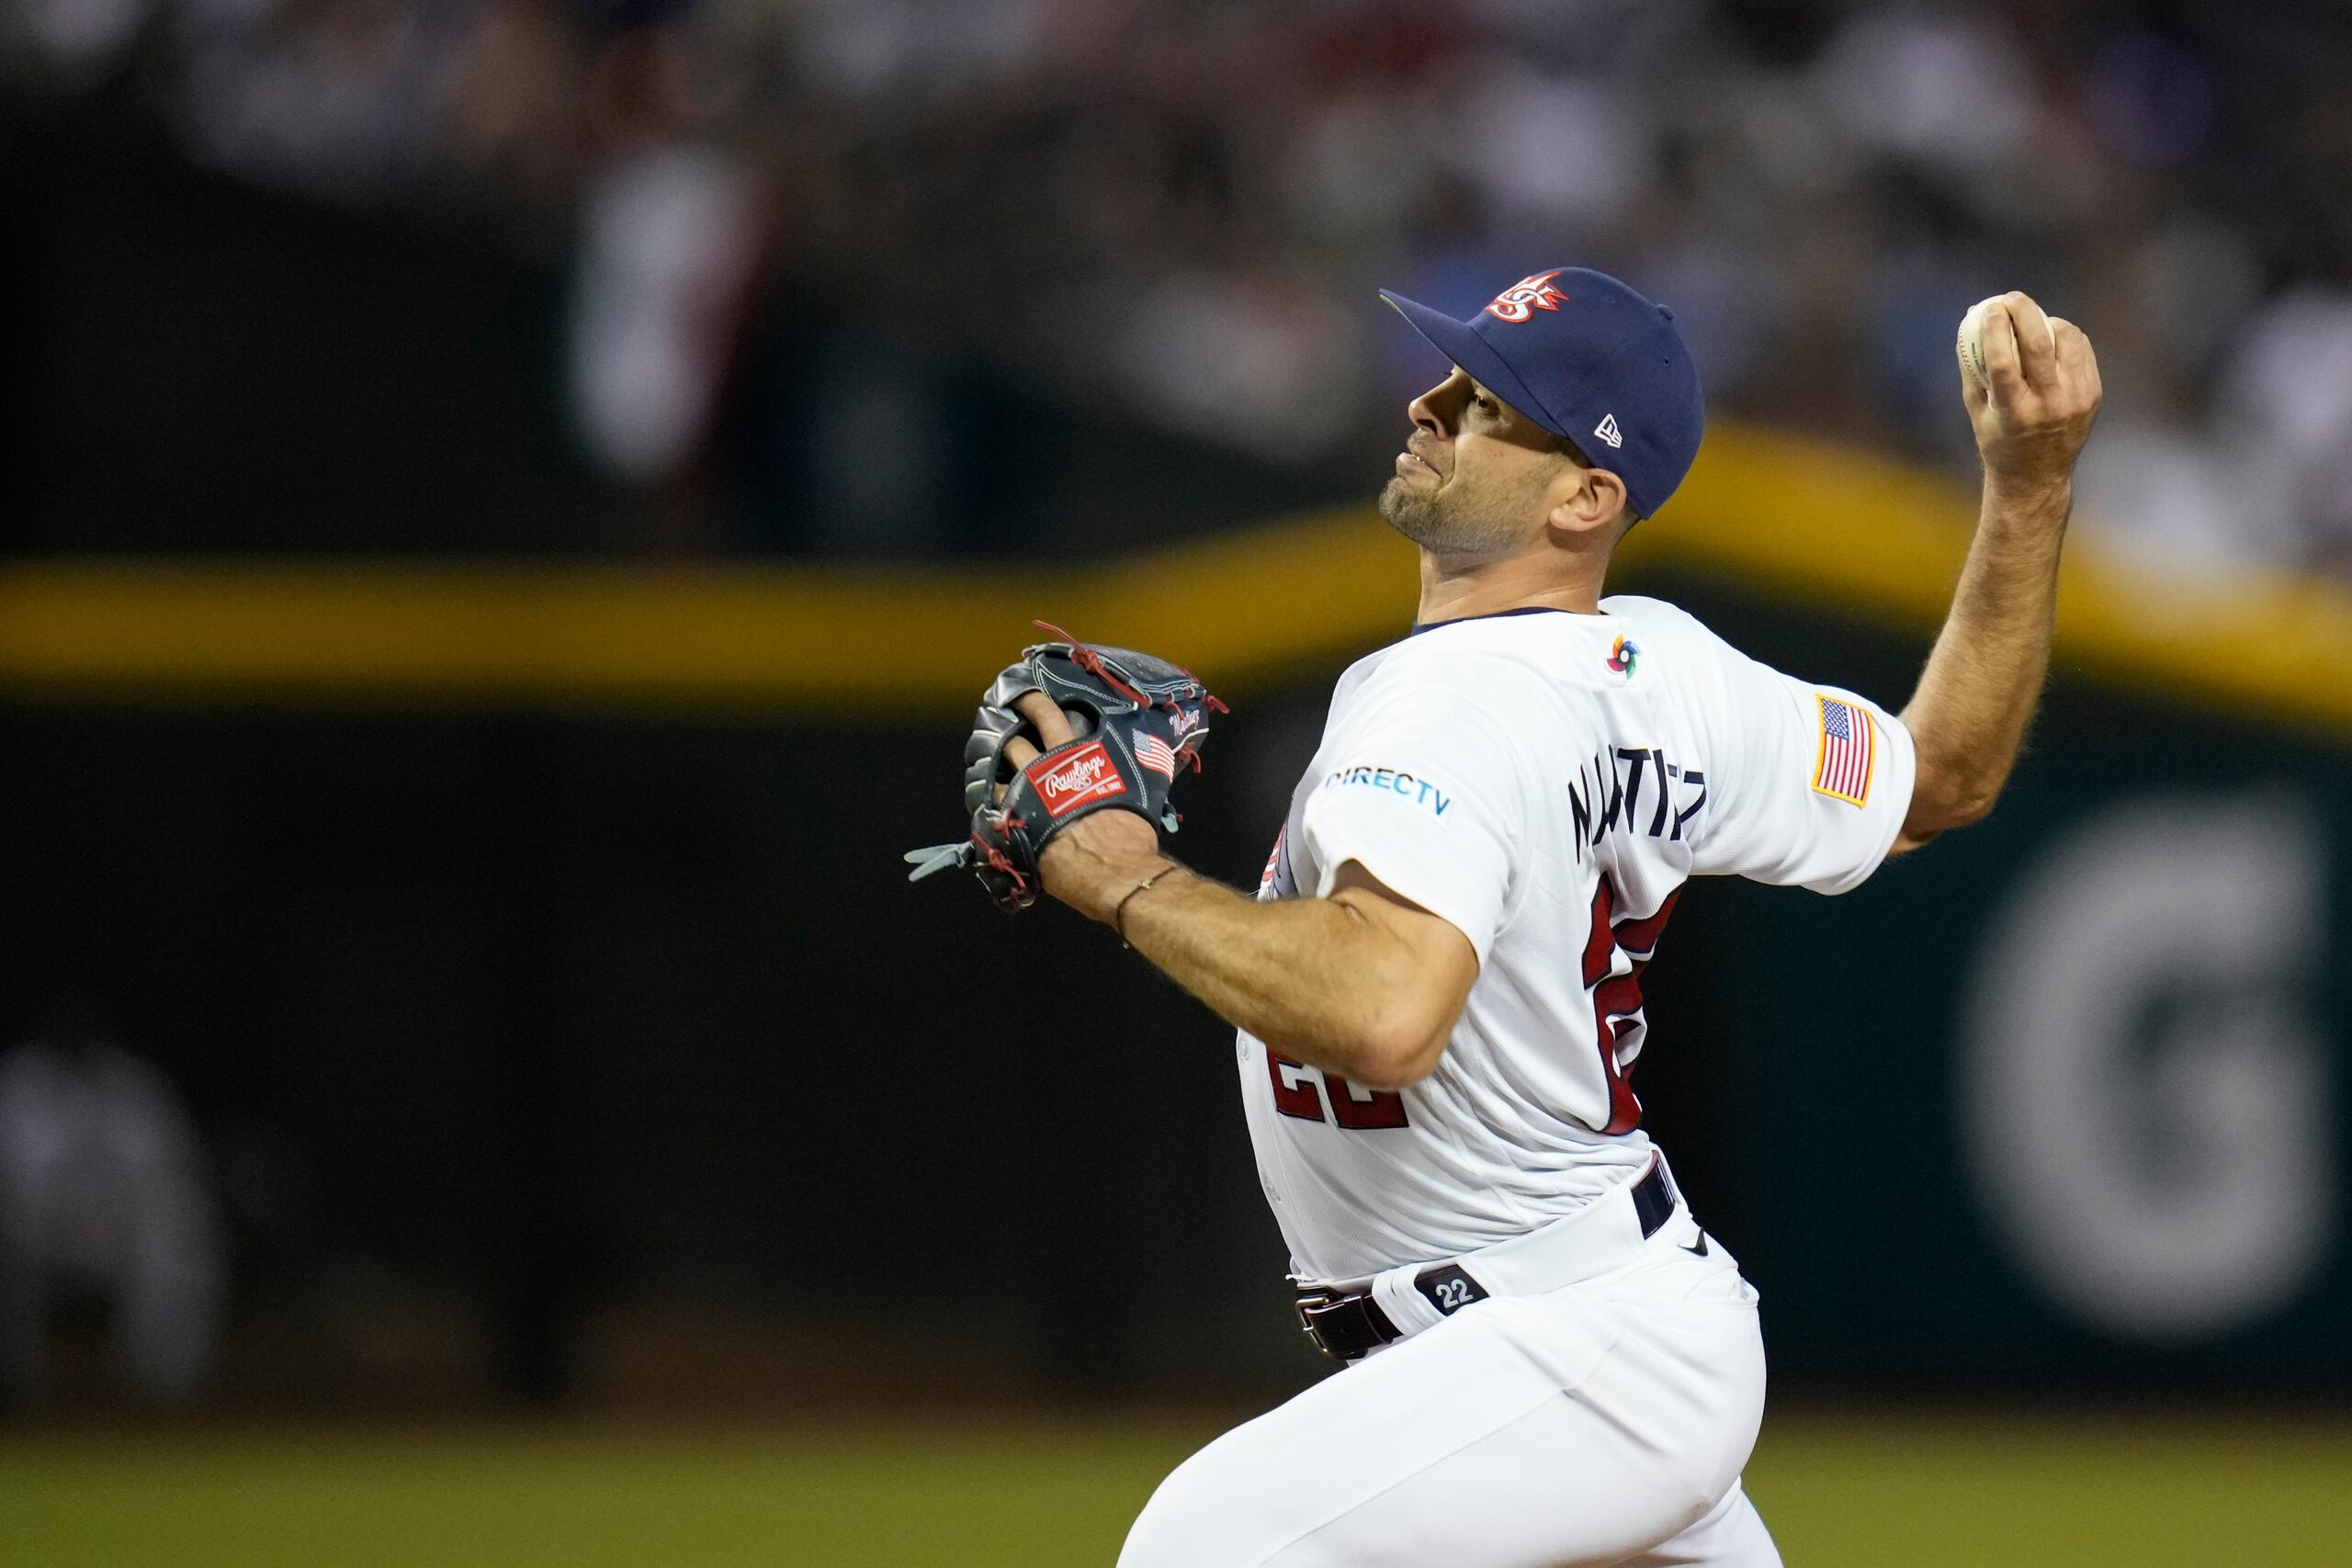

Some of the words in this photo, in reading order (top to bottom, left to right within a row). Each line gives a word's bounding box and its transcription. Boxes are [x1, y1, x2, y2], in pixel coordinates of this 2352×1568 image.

[1045, 755, 1105, 798] Rawlings
[1957, 795, 2332, 1332] G
[1435, 1279, 1474, 1308] 22
